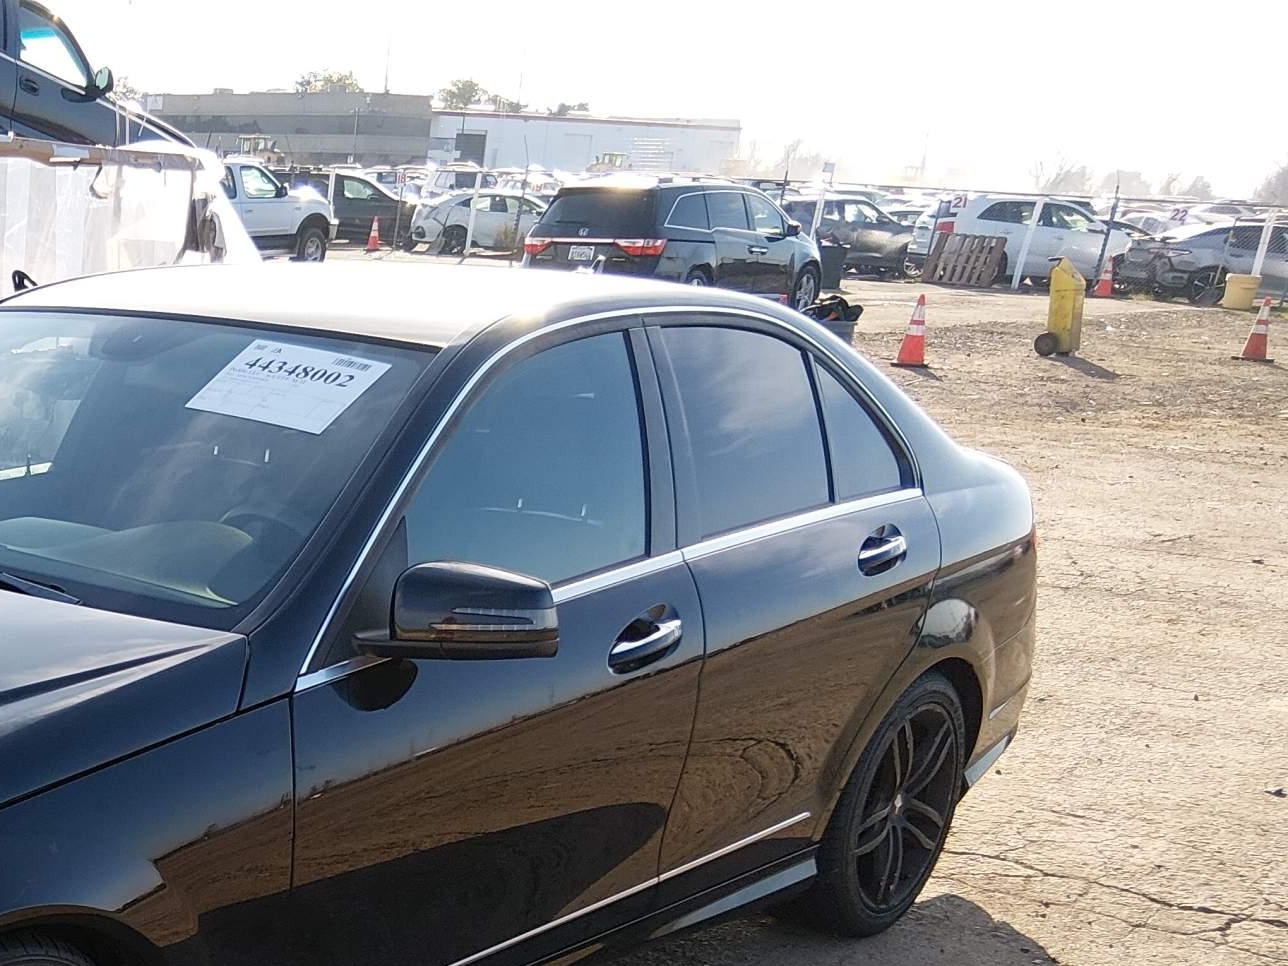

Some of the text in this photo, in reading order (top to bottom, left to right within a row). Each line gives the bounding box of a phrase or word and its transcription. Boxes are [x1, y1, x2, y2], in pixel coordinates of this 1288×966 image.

[952, 196, 968, 209] 21
[1169, 208, 1189, 221] 22
[244, 356, 357, 388] 44348002
